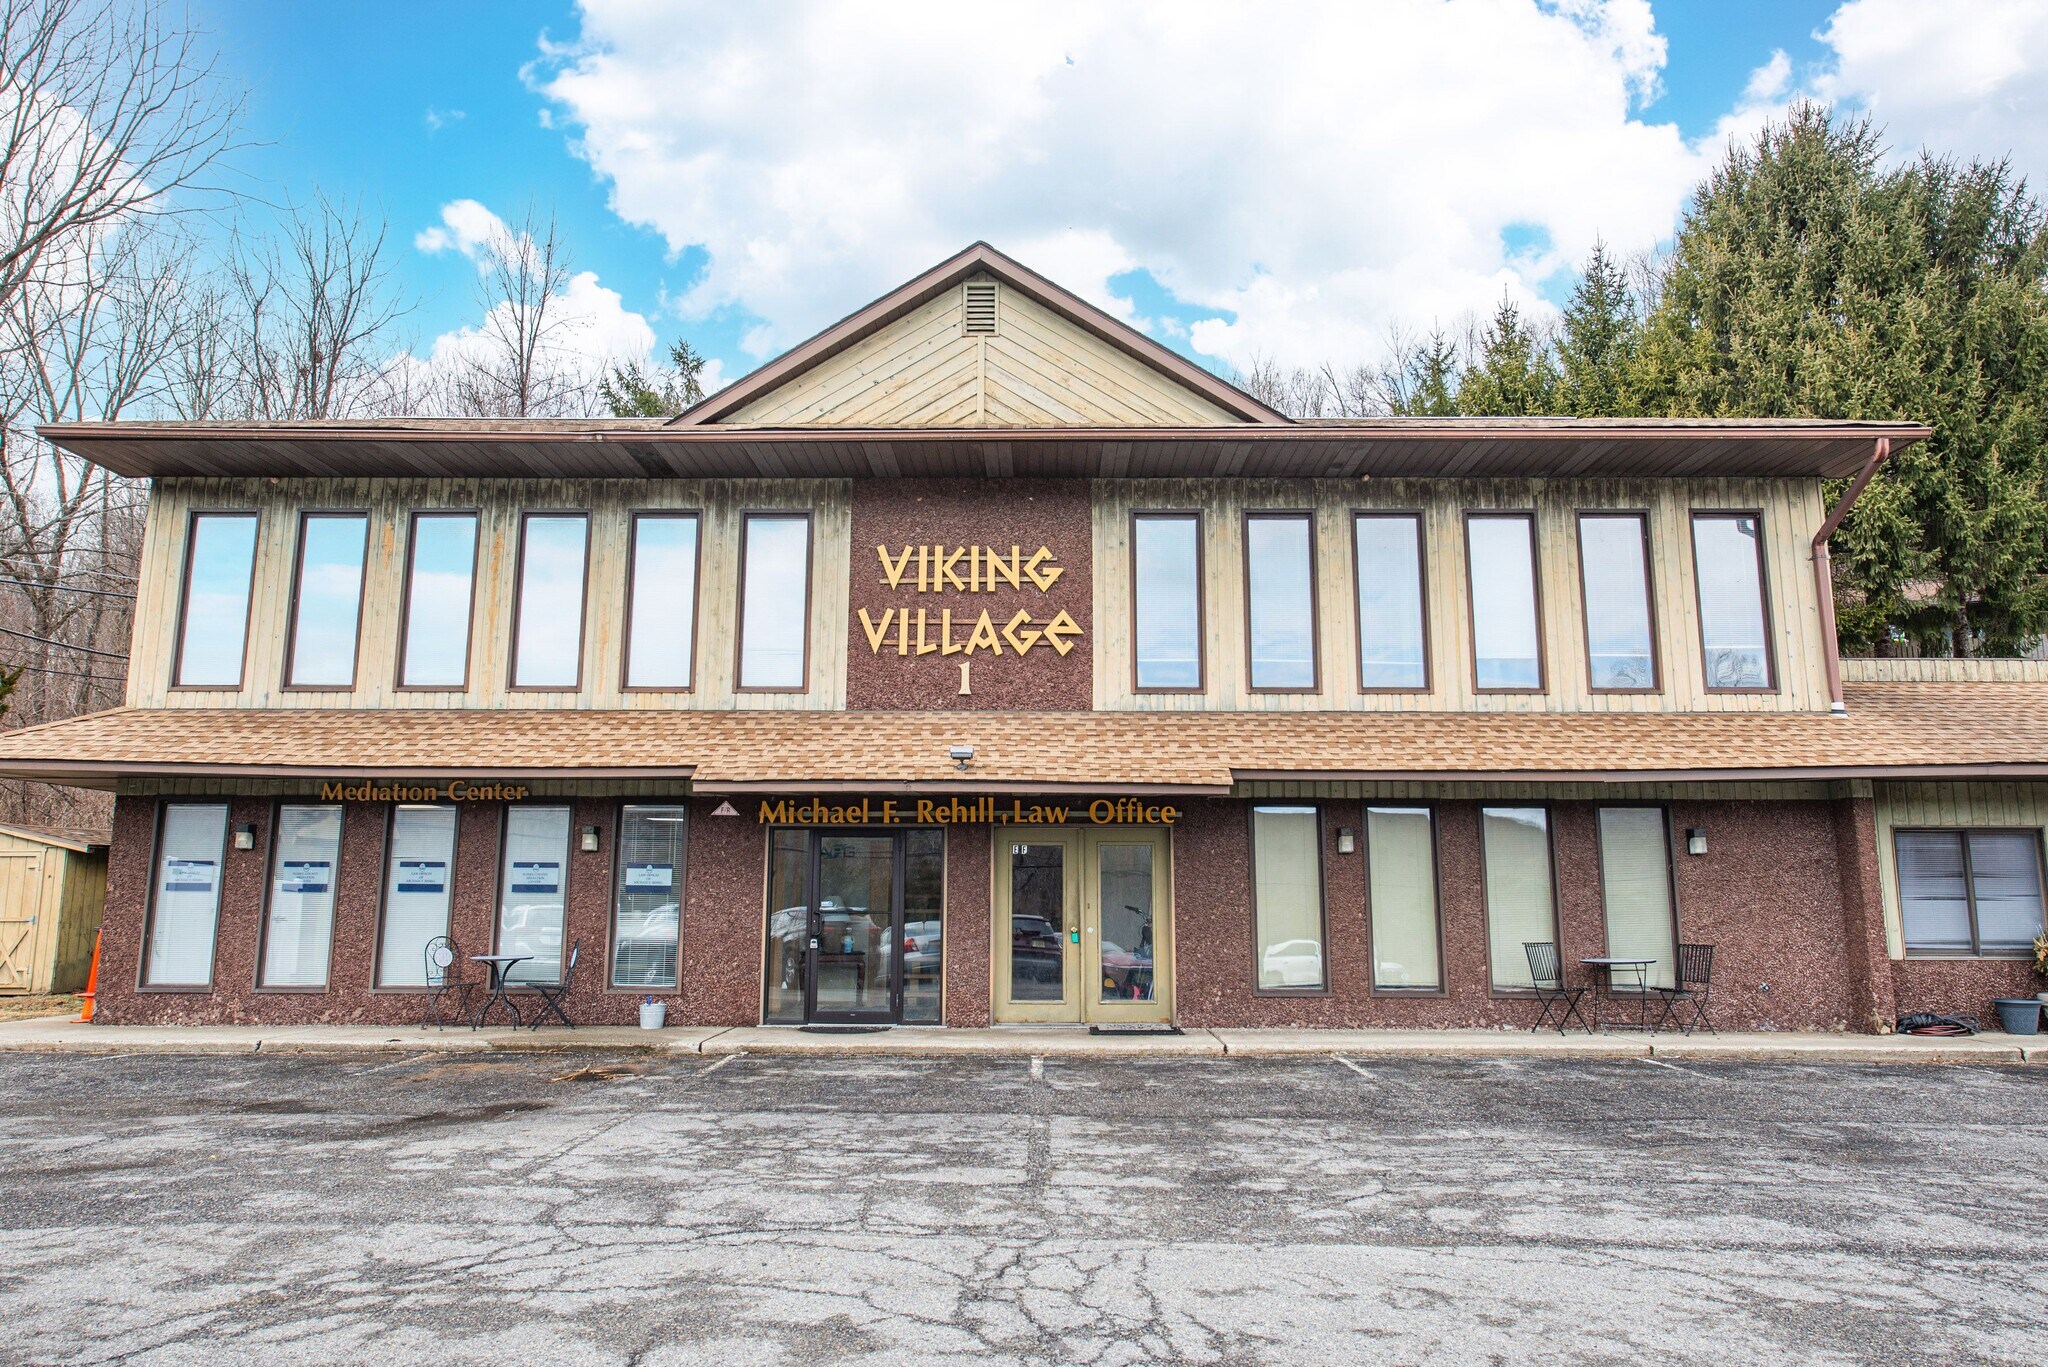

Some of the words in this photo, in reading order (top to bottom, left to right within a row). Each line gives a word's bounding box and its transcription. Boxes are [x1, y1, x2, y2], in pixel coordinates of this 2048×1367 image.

[876, 544, 1065, 593] VIKING
[857, 607, 1085, 657] VILLAGE
[958, 661, 972, 695] 1
[321, 780, 437, 801] Mediation
[448, 780, 527, 801] Center
[759, 797, 869, 824] Michael
[883, 800, 900, 824] F.
[1014, 799, 1070, 824] Law
[1089, 797, 1176, 824] Office
